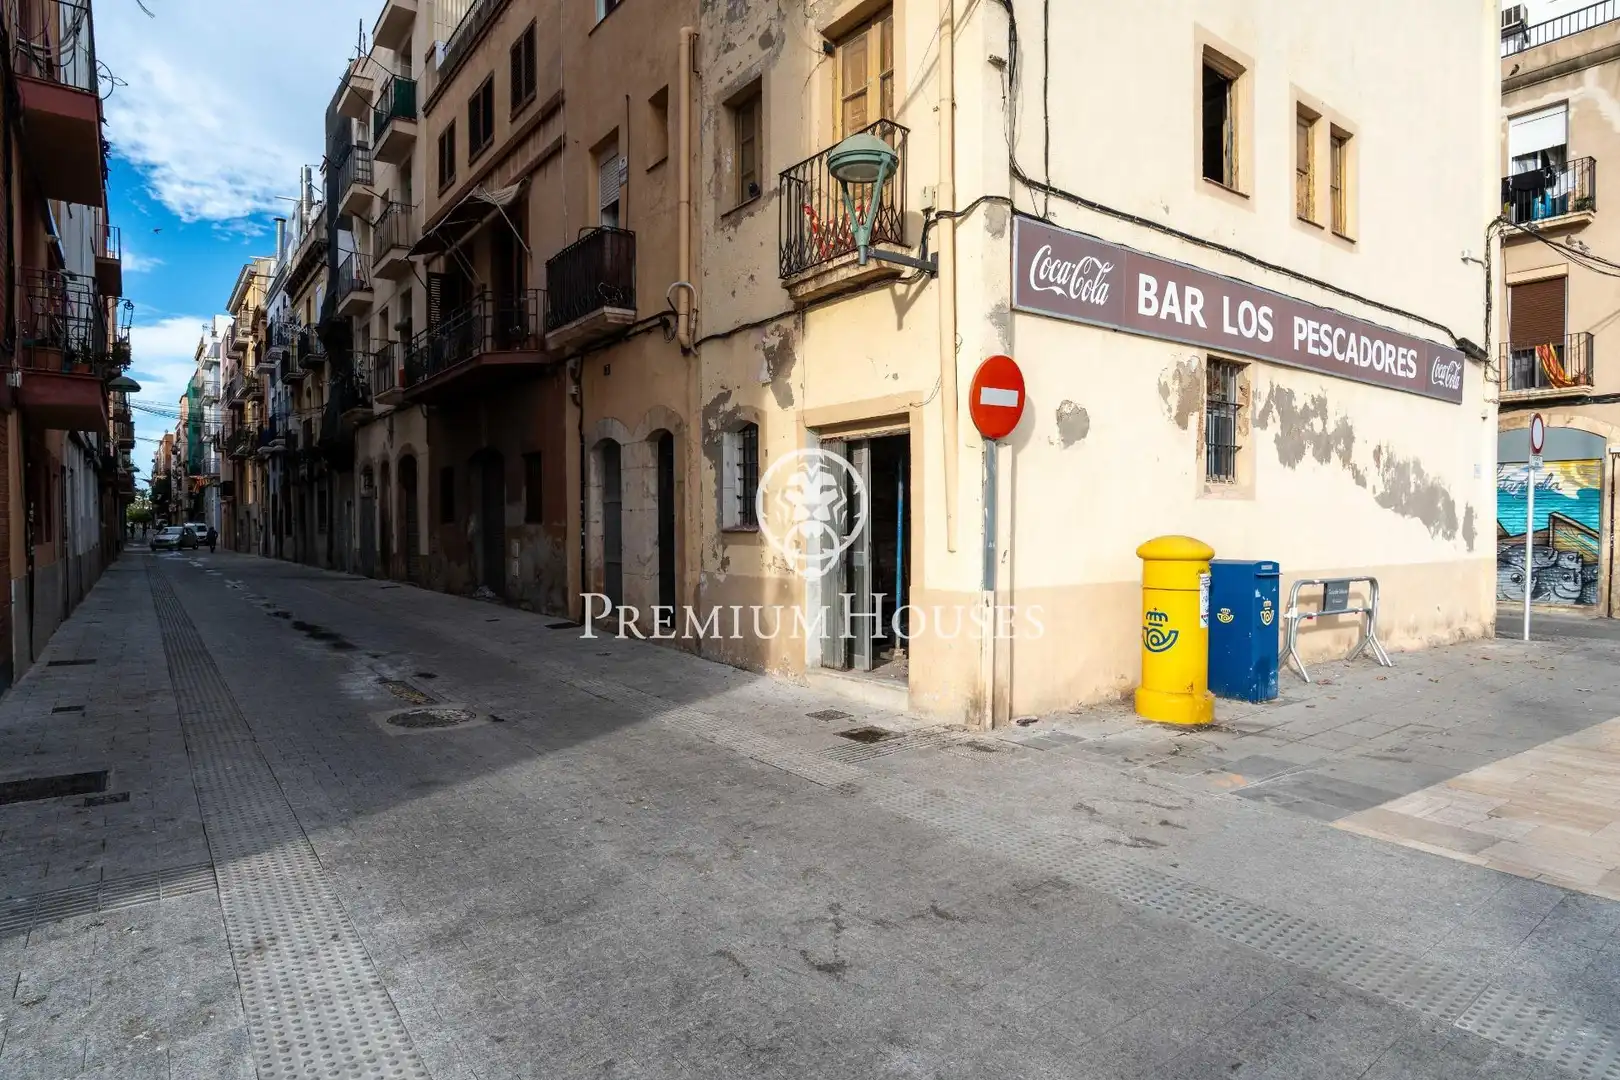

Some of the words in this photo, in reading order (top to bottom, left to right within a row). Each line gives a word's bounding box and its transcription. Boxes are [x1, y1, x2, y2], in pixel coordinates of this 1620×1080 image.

[1029, 244, 1115, 306] Coca-Cola
[1137, 272, 1208, 330] BAR
[1223, 295, 1274, 343] LOS
[1293, 315, 1418, 379] PESCADORES
